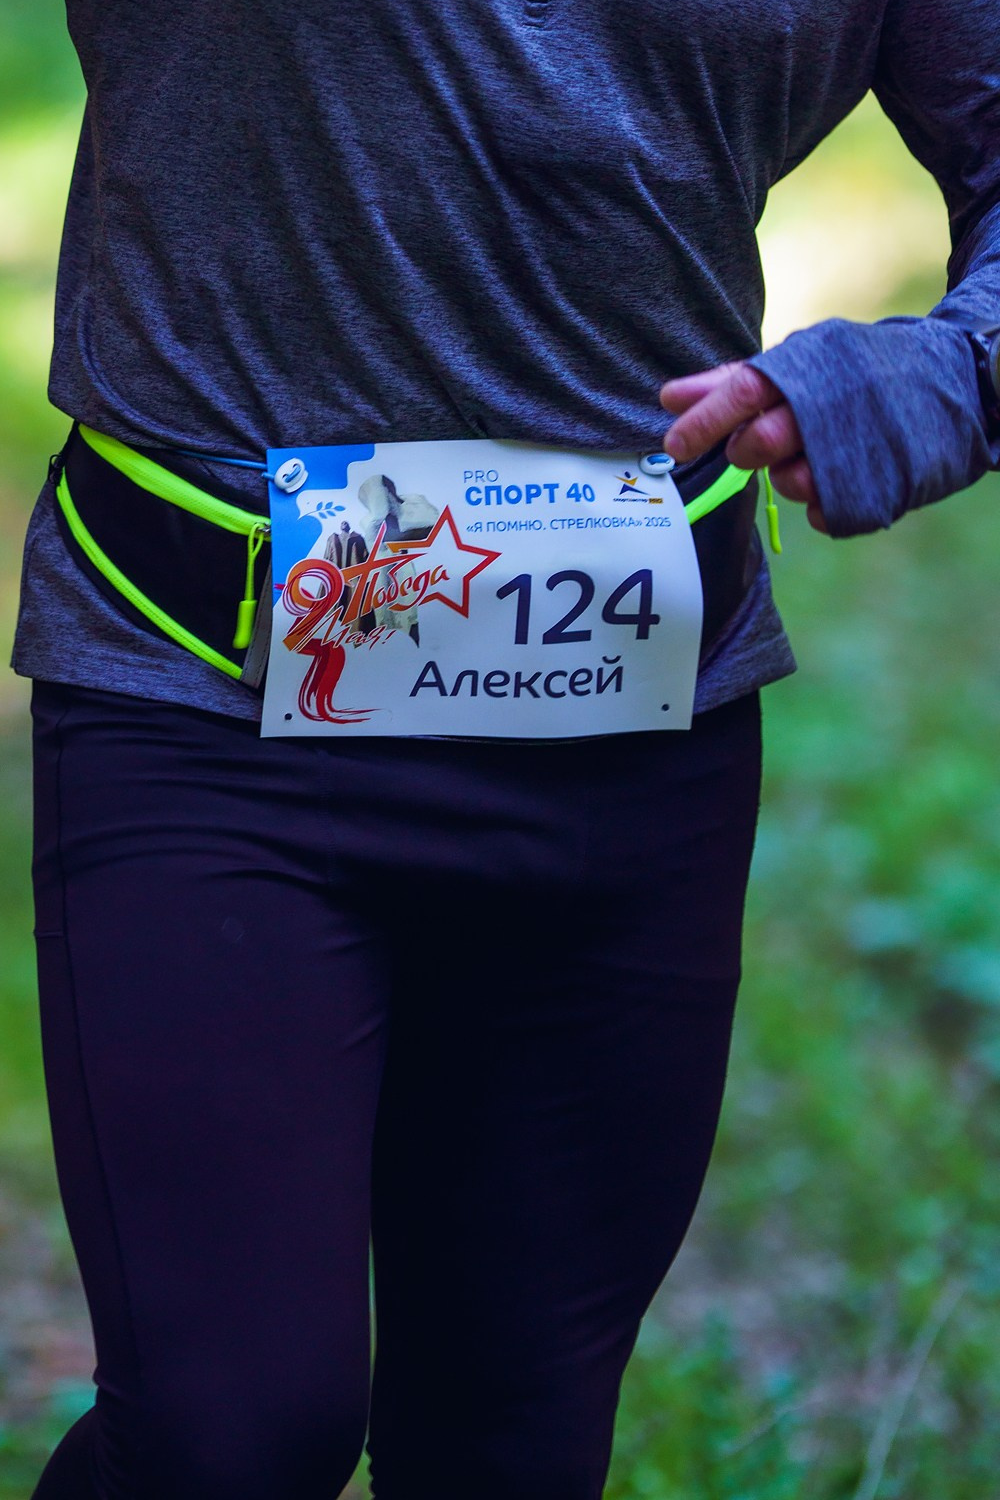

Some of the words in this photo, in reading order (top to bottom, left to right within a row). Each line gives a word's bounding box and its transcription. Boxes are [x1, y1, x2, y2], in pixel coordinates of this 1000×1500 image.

[463, 469, 499, 484] PRO
[465, 483, 560, 506] СПОРТ
[566, 482, 596, 503] 40
[466, 522, 484, 534] «Я
[486, 519, 547, 533] ПОМНЮ.
[549, 516, 642, 531] СТРЕЛКОВКА»
[644, 516, 672, 528] 2025
[496, 568, 661, 645] 124
[409, 655, 624, 698] Алексей
